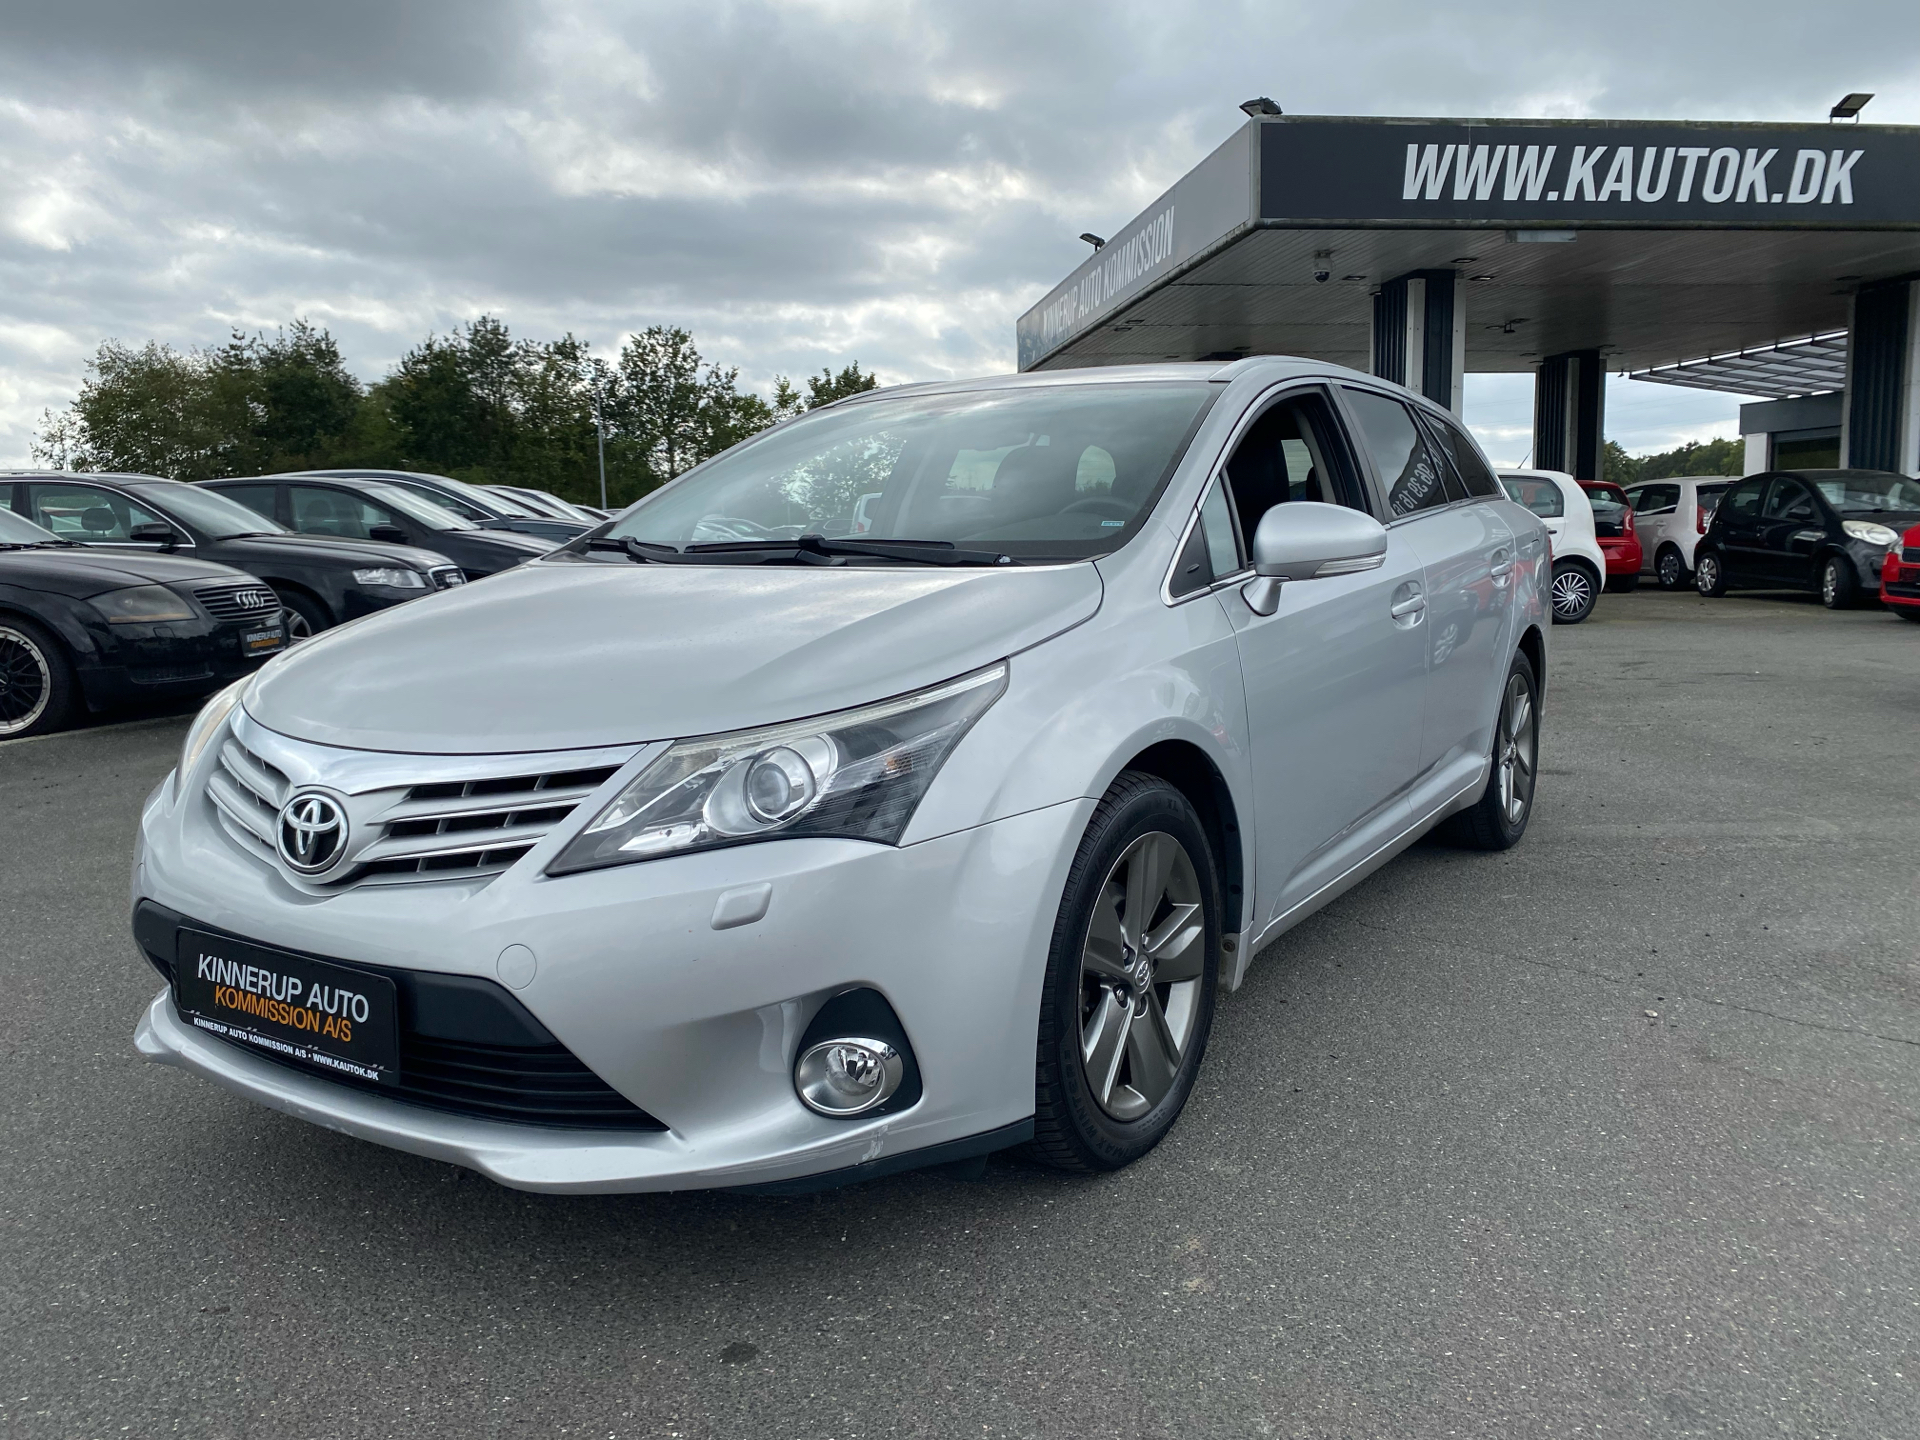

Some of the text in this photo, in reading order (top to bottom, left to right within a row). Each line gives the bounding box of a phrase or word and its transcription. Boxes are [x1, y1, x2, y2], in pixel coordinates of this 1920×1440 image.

[1402, 142, 1865, 205] WWW.KAUTOK.DK
[1078, 265, 1102, 319] AUTO
[1103, 205, 1175, 302] KOMMISSION
[198, 953, 370, 1024] KINNERUP AUTO
[215, 985, 352, 1043] KOMMISSION A/S
[193, 1016, 379, 1082] KINNERUP AUTO KOMMISSION A/S WWW.KAUTOK.DK
